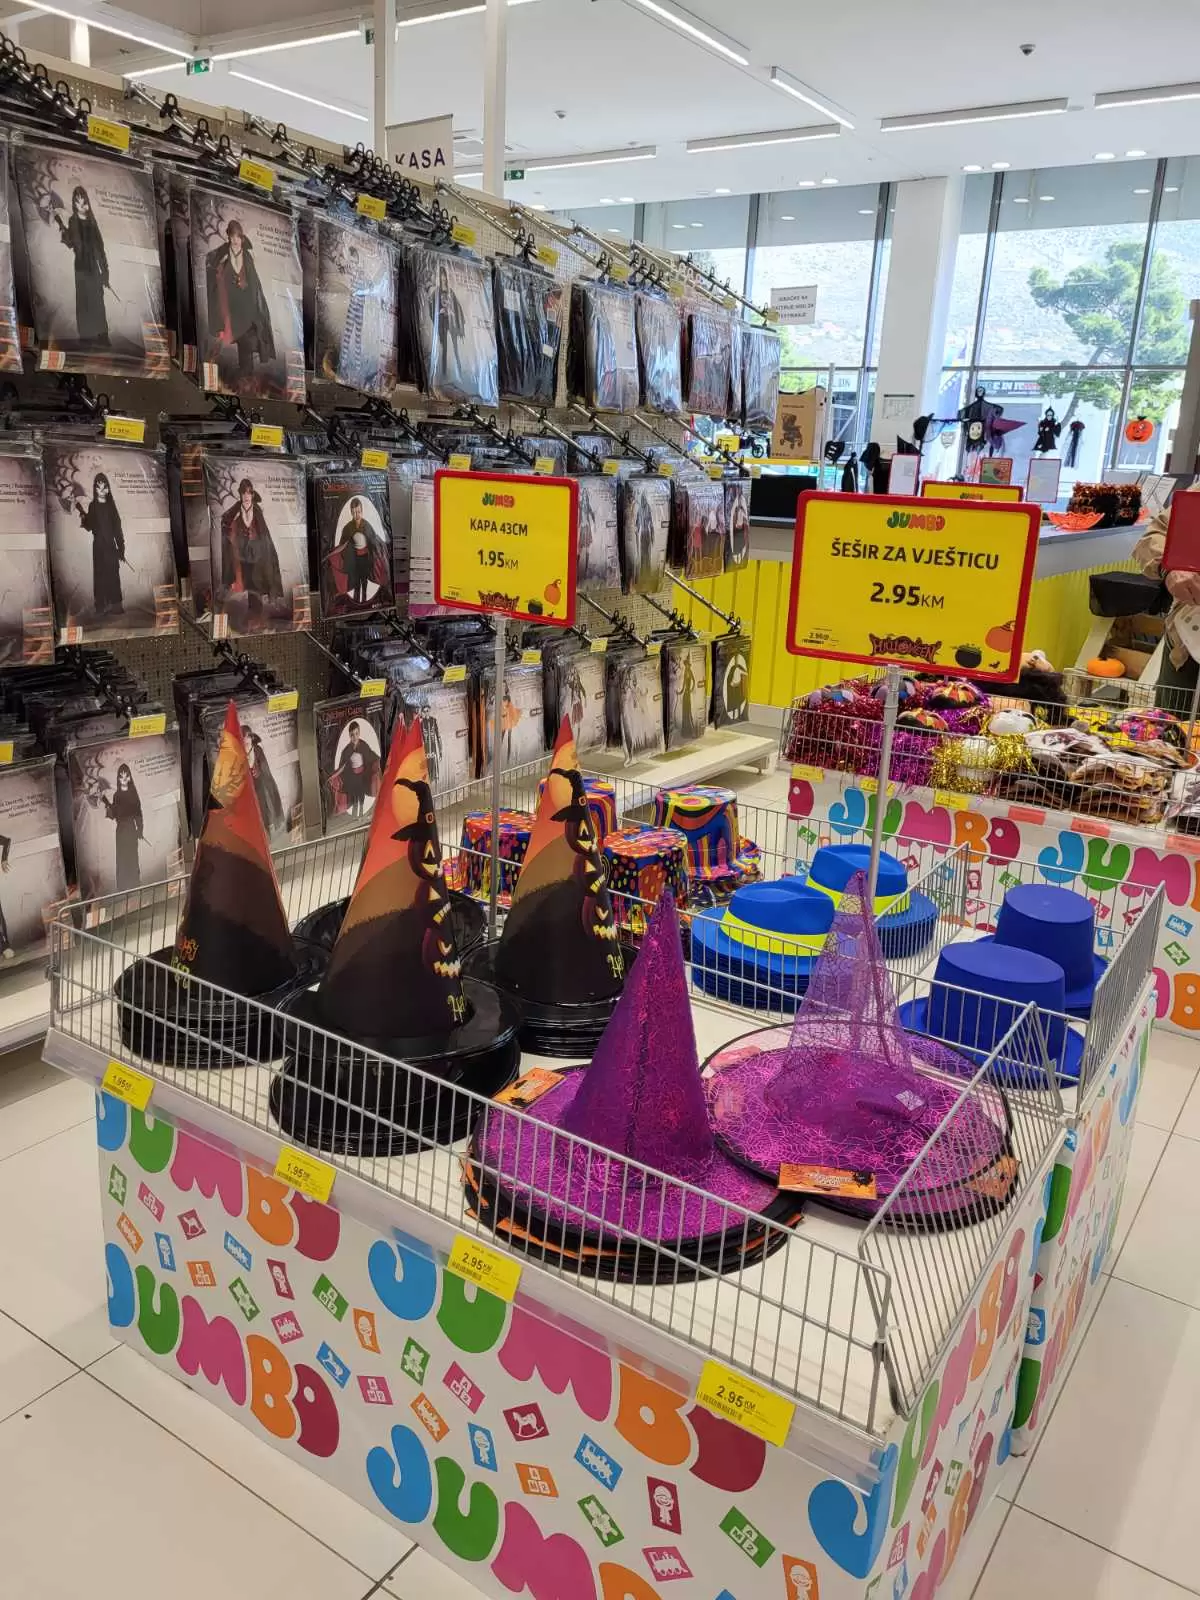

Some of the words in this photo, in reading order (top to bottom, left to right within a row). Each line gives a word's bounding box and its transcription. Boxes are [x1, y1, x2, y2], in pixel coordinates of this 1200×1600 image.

[395, 148, 445, 170] KASA
[470, 518, 497, 534] KAPA
[500, 522, 528, 536] 43CM
[886, 511, 945, 531] JUMBO
[831, 537, 878, 560] ŠEŠIR
[883, 545, 906, 562] ZA
[912, 546, 999, 570] VJEŠTICU
[828, 786, 1021, 867] JUMBO
[1038, 830, 1200, 906] JUM
[106, 1243, 340, 1458] JUMBO
[366, 1424, 664, 1600] JUM
